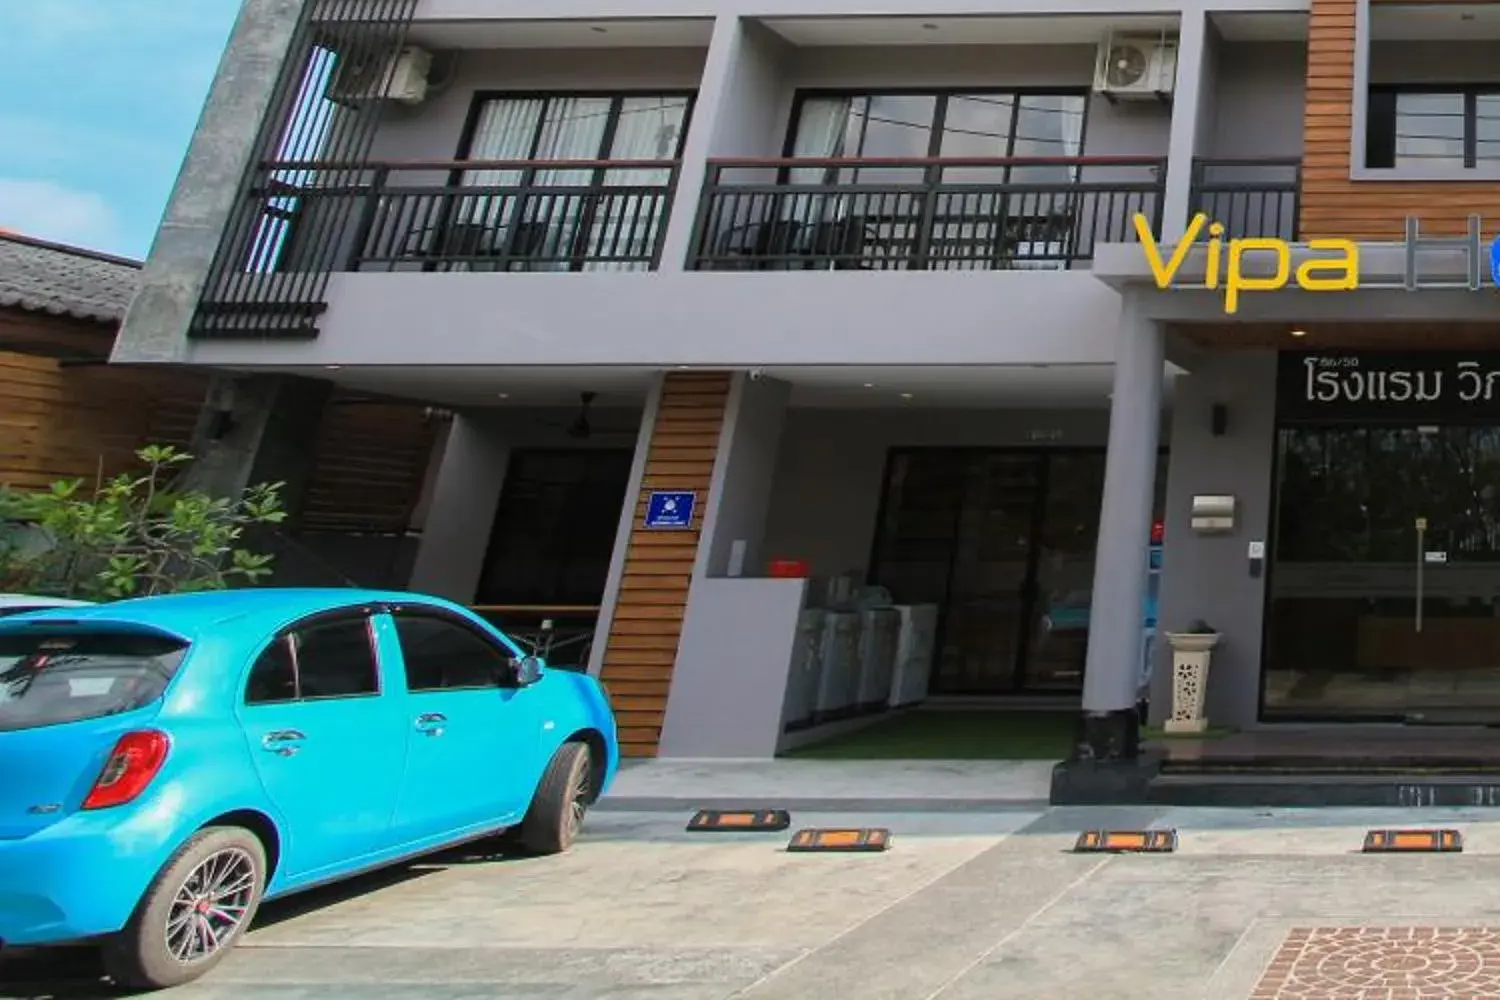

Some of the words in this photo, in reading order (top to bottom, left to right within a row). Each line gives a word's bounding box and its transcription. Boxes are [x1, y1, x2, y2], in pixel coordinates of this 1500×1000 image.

[1132, 211, 1360, 314] Vipa
[1303, 356, 1443, 402] โรงแรม
